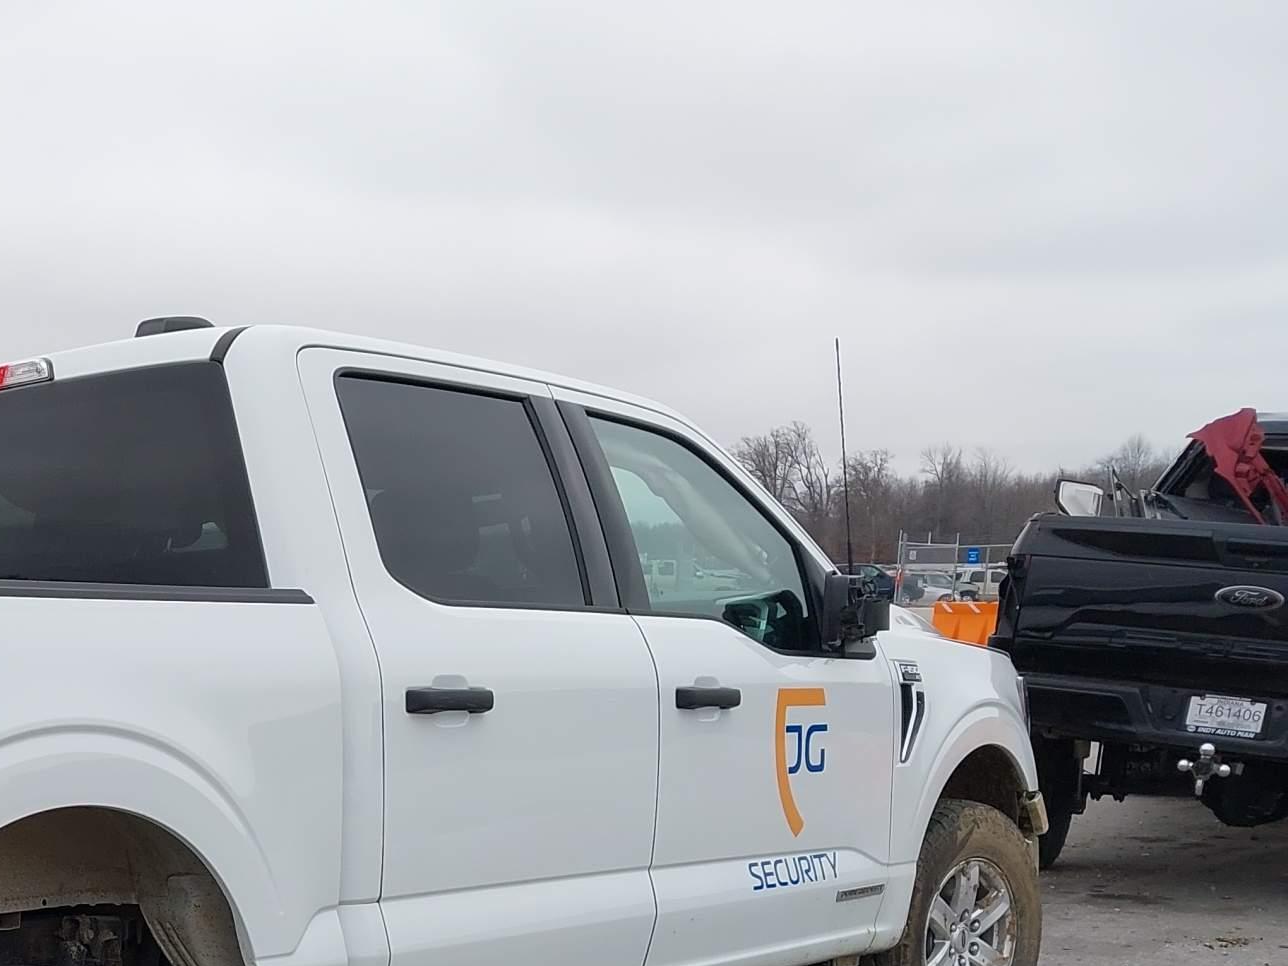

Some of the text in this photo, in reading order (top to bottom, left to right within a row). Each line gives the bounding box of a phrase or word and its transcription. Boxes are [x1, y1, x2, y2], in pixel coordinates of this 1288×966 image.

[1231, 590, 1269, 607] Ford
[1196, 703, 1262, 722] T461406
[1197, 726, 1217, 734] INDY
[1215, 728, 1237, 737] AUTO
[748, 851, 839, 891] SECURITY
